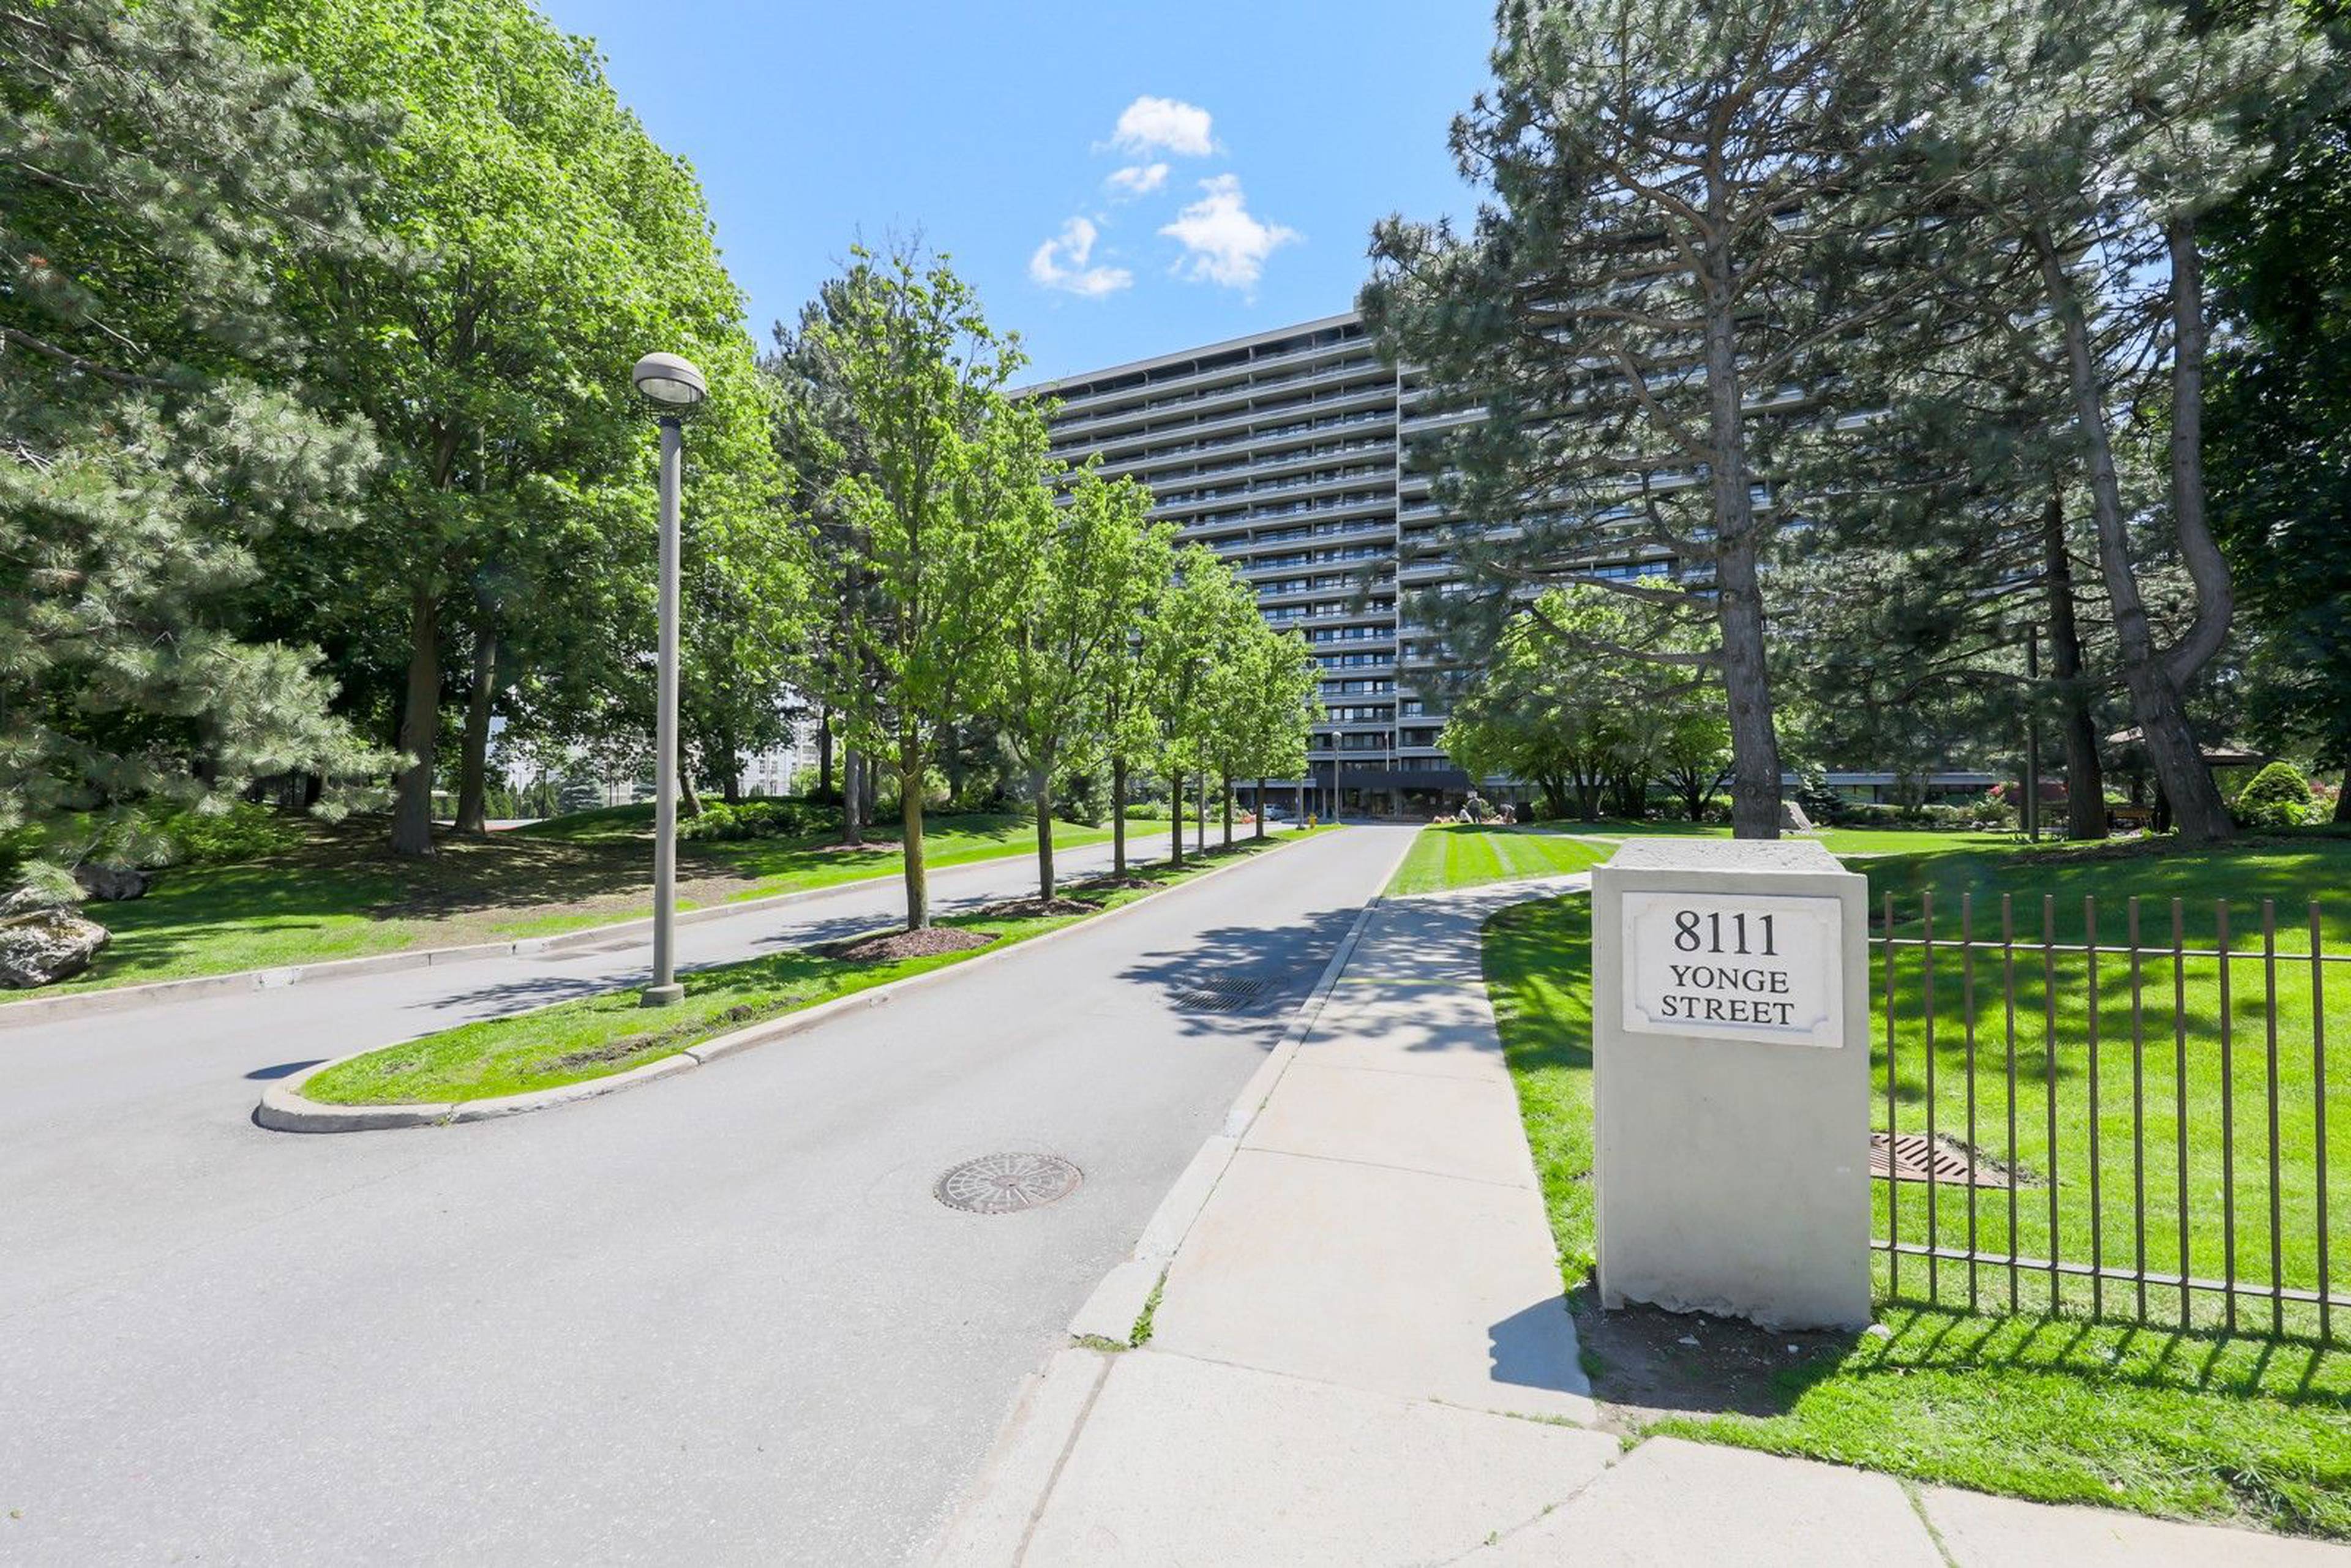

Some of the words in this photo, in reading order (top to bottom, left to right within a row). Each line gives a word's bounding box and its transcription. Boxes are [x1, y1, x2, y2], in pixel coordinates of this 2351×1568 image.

[1674, 910, 1778, 956] 8111
[1670, 965, 1789, 993] YONGE
[1661, 995, 1794, 1025] STREET
